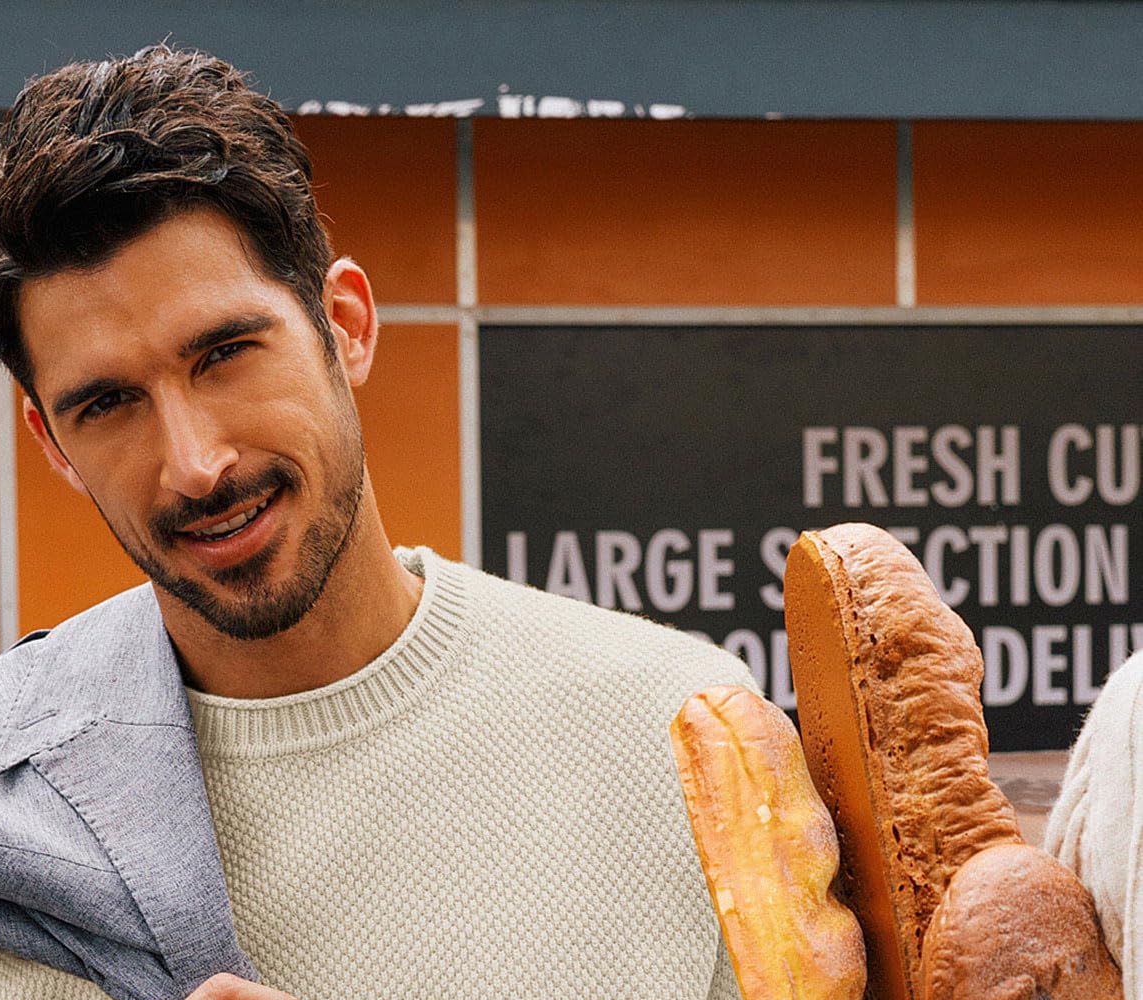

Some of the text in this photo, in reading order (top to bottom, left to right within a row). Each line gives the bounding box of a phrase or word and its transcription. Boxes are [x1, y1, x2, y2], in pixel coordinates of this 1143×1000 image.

[802, 423, 1143, 507] FRESH CU
[759, 525, 1129, 608] SCTION
